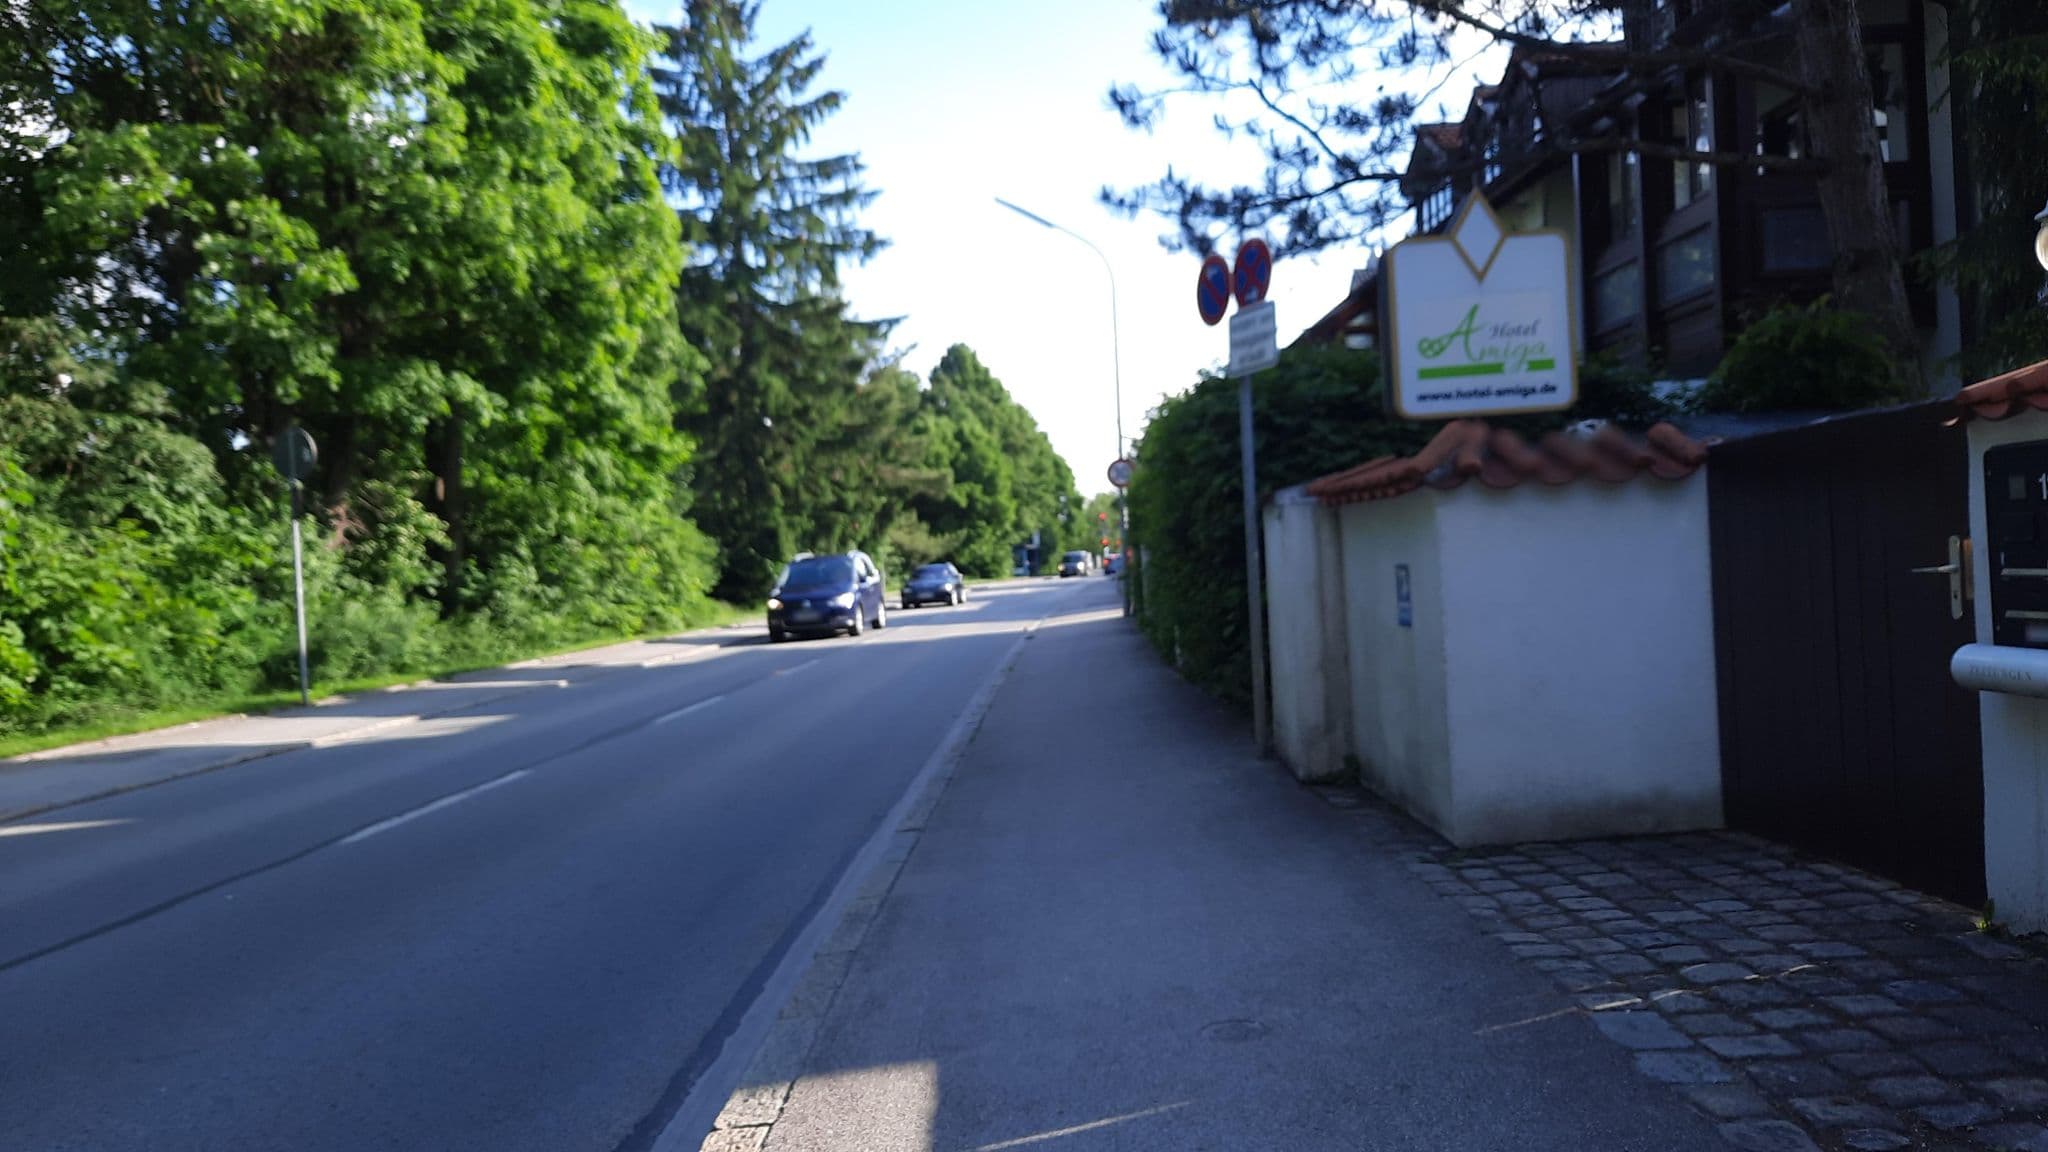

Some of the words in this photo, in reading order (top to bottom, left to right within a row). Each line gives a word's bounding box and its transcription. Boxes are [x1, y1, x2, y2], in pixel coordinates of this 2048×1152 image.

[1418, 303, 1546, 373] Amiga
[1489, 318, 1541, 339] Hotel
[1416, 382, 1557, 402] www.hotel-amiga.de
